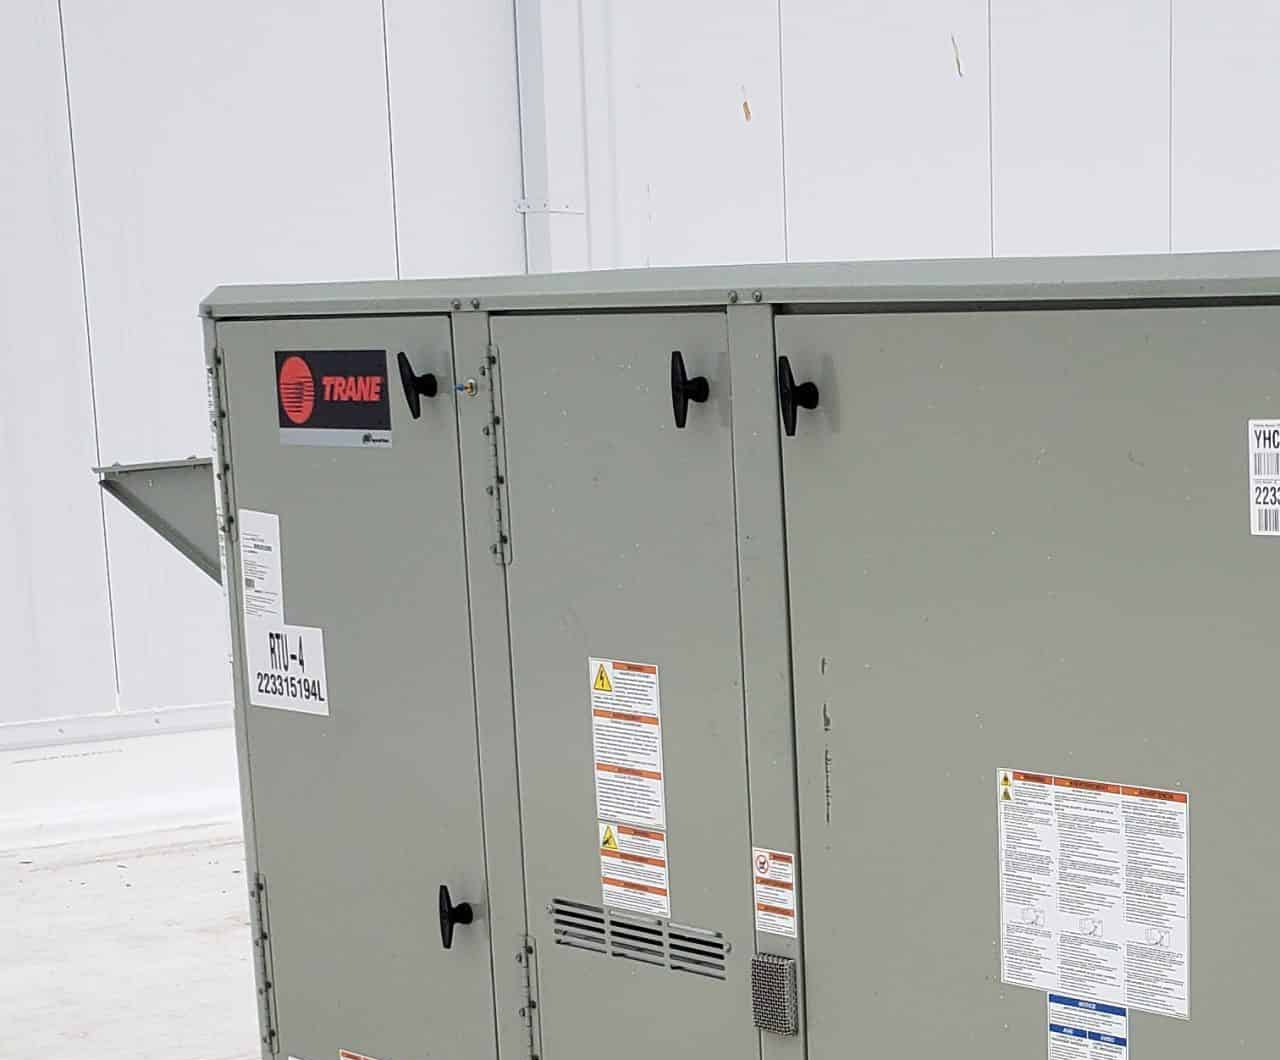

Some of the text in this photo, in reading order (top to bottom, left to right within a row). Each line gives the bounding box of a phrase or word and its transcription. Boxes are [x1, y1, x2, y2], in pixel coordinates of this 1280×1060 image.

[321, 375, 383, 403] TRANE
[268, 631, 305, 673] RTU-4
[256, 671, 325, 702] 223315194L
